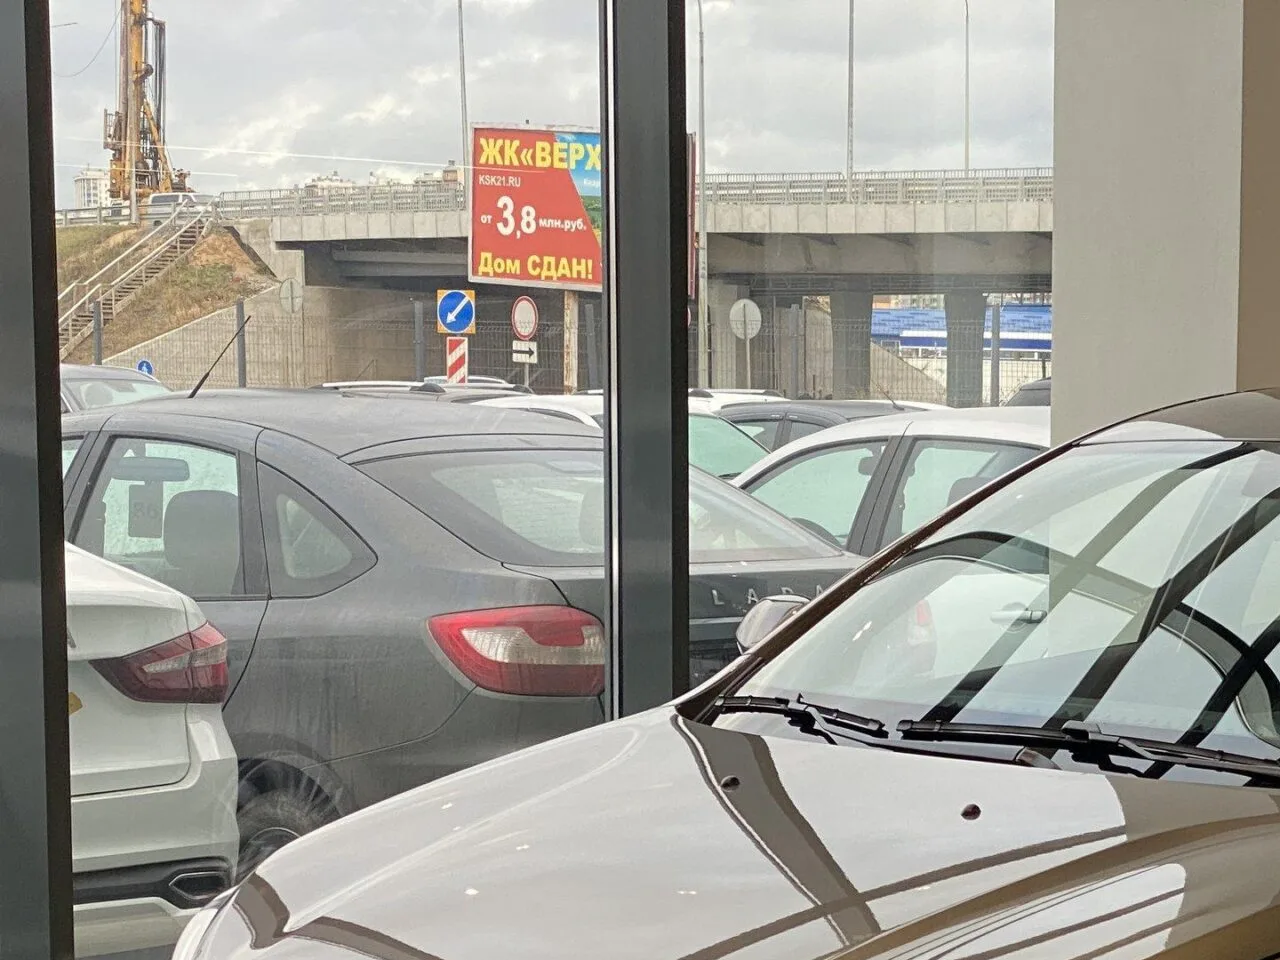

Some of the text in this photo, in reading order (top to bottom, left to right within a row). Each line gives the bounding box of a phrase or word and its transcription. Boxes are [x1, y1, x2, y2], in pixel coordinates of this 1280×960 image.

[478, 174, 521, 187] KSK21.RU
[480, 214, 493, 224] от
[496, 195, 537, 239] 3,8
[478, 251, 593, 280] Дом СДАН!
